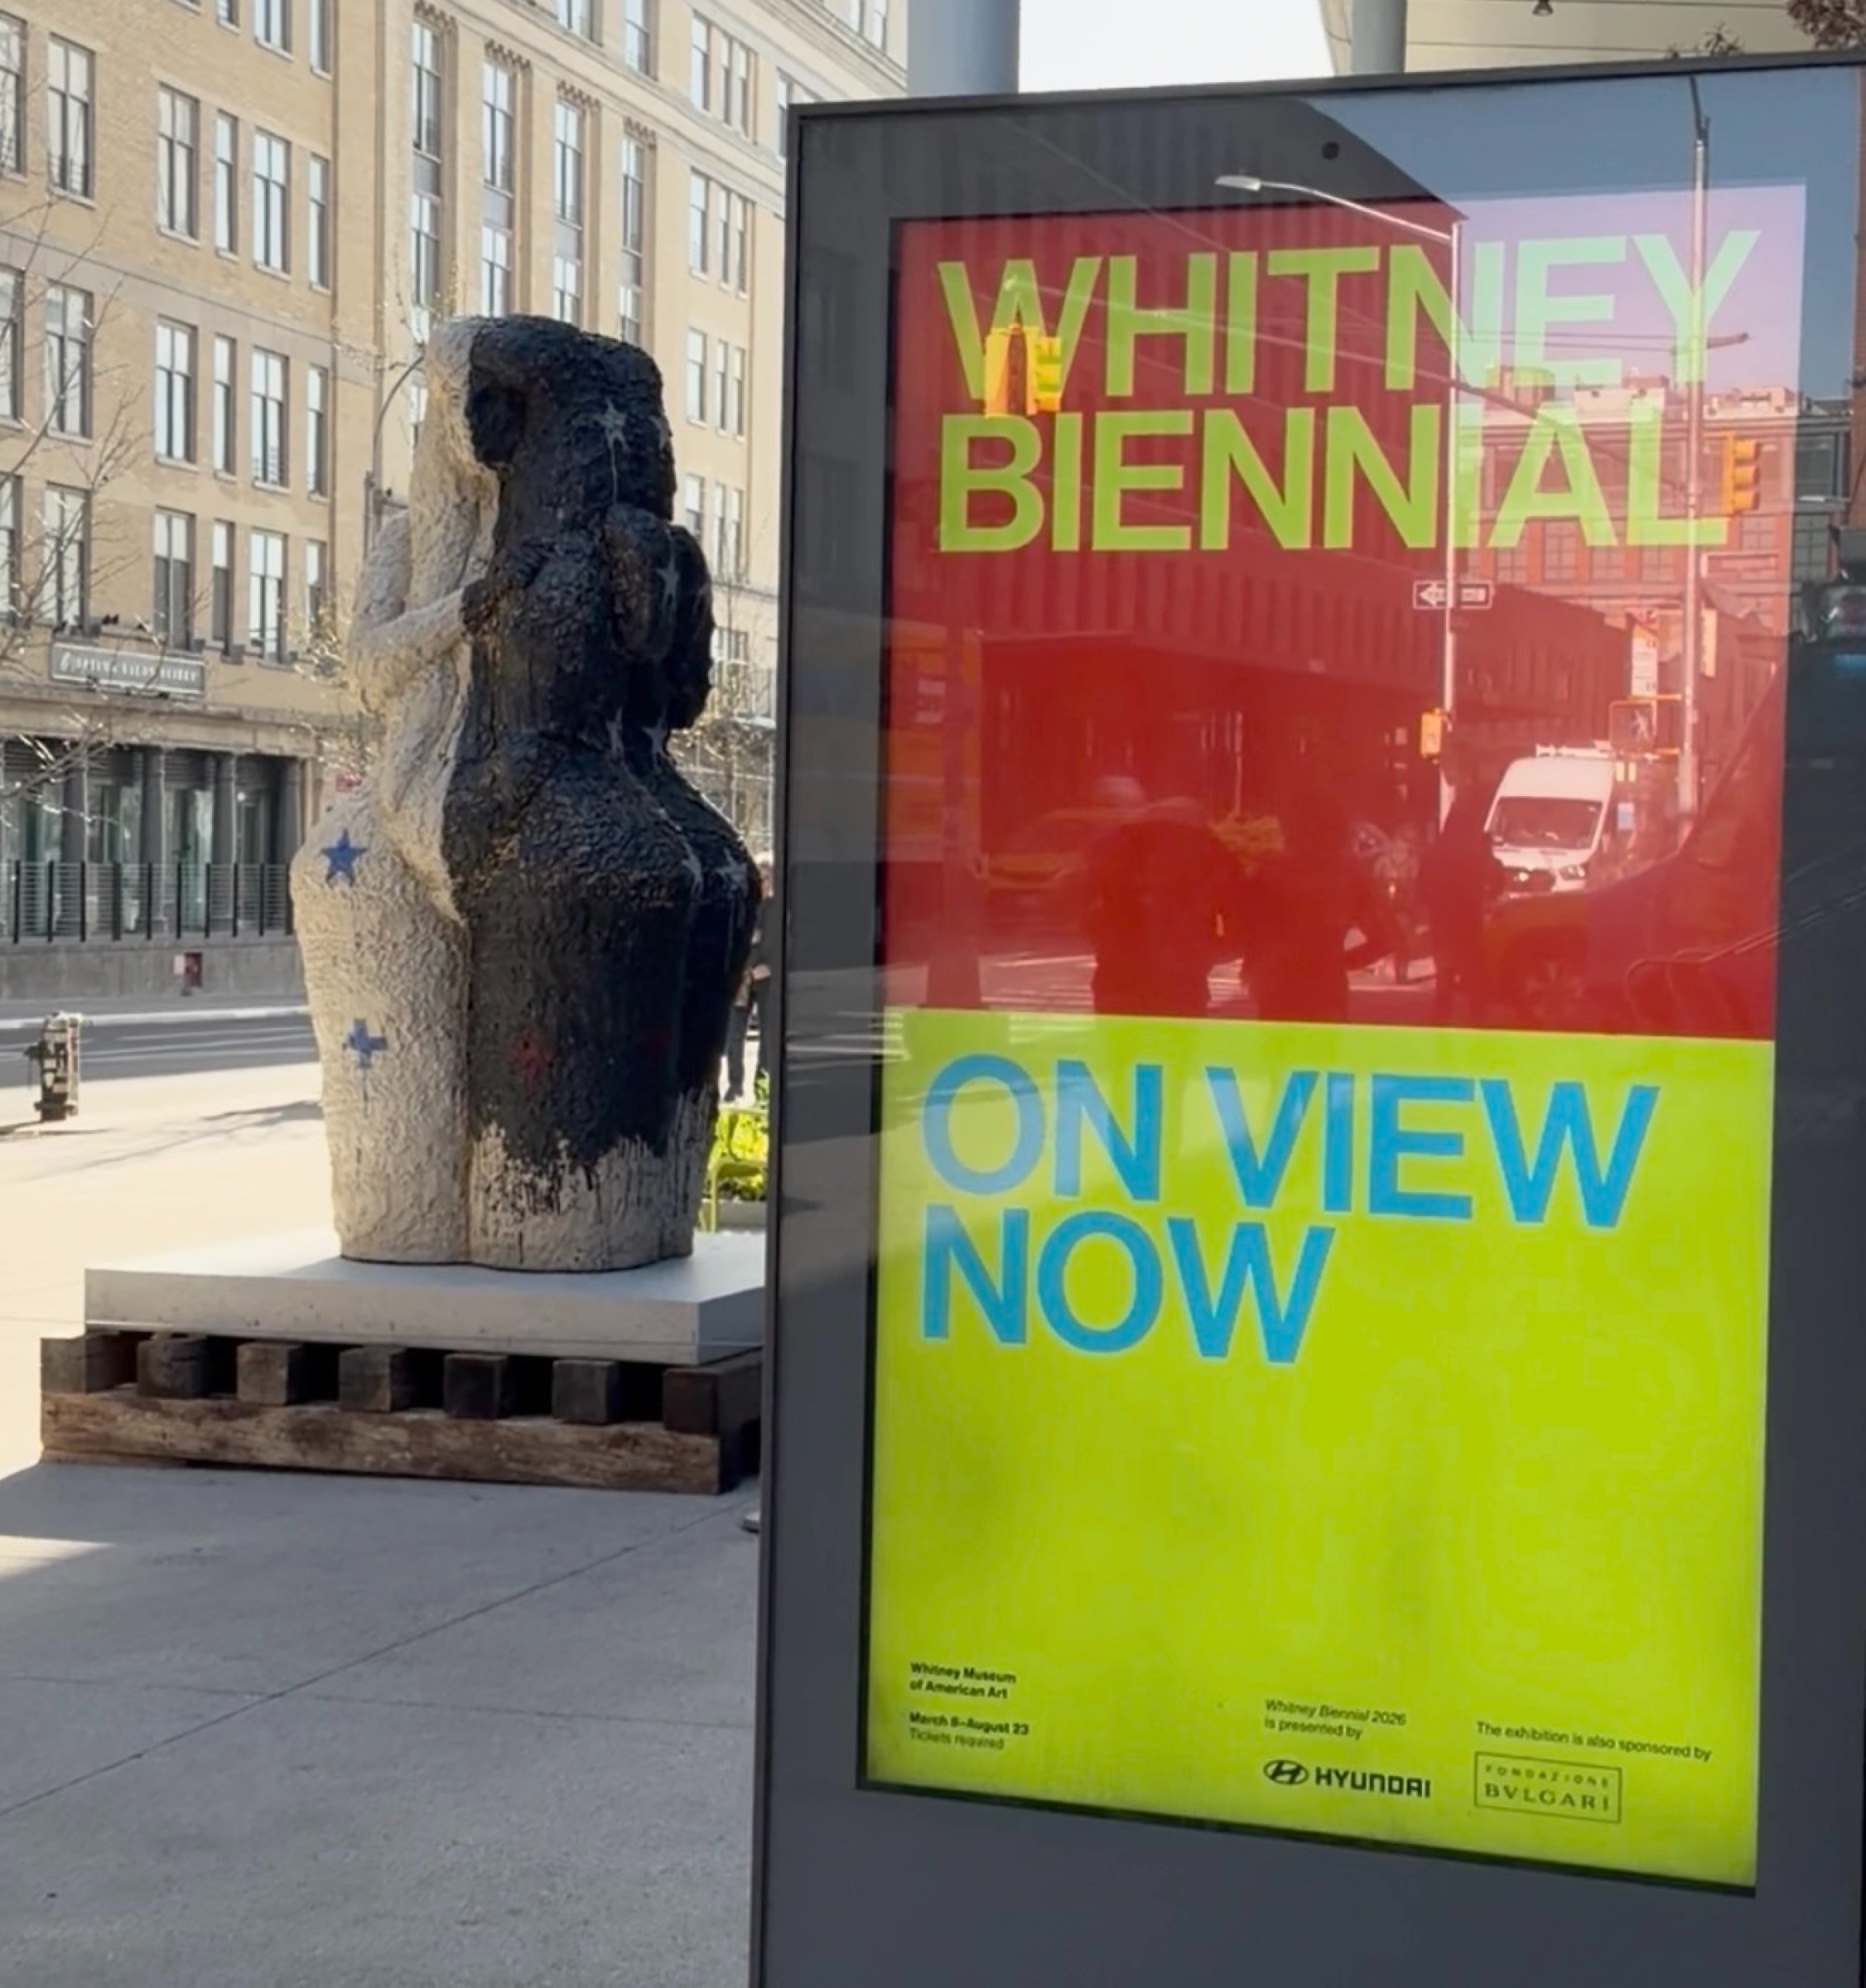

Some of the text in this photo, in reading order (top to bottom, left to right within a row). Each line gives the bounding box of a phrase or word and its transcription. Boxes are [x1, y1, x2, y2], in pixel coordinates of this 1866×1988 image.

[937, 229, 1762, 401] WHITNEY
[938, 399, 1729, 552] BIENNIAL
[922, 1053, 1660, 1228] ON VIEW
[922, 1203, 1336, 1364] NOW
[910, 1662, 1017, 1683] Whitney Museum
[910, 1680, 1008, 1699] of American Art
[909, 1711, 948, 1727] March
[1012, 1723, 1029, 1735] 23
[1265, 1699, 1406, 1725] Whitney Biennial 2026
[909, 1728, 1005, 1750] Tickets required
[1265, 1717, 1363, 1740] is presented by
[1477, 1721, 1712, 1762] The exhibition is also sponsored by
[1314, 1766, 1431, 1798] HYUNDAI
[1484, 1783, 1609, 1812] BVLGARI
